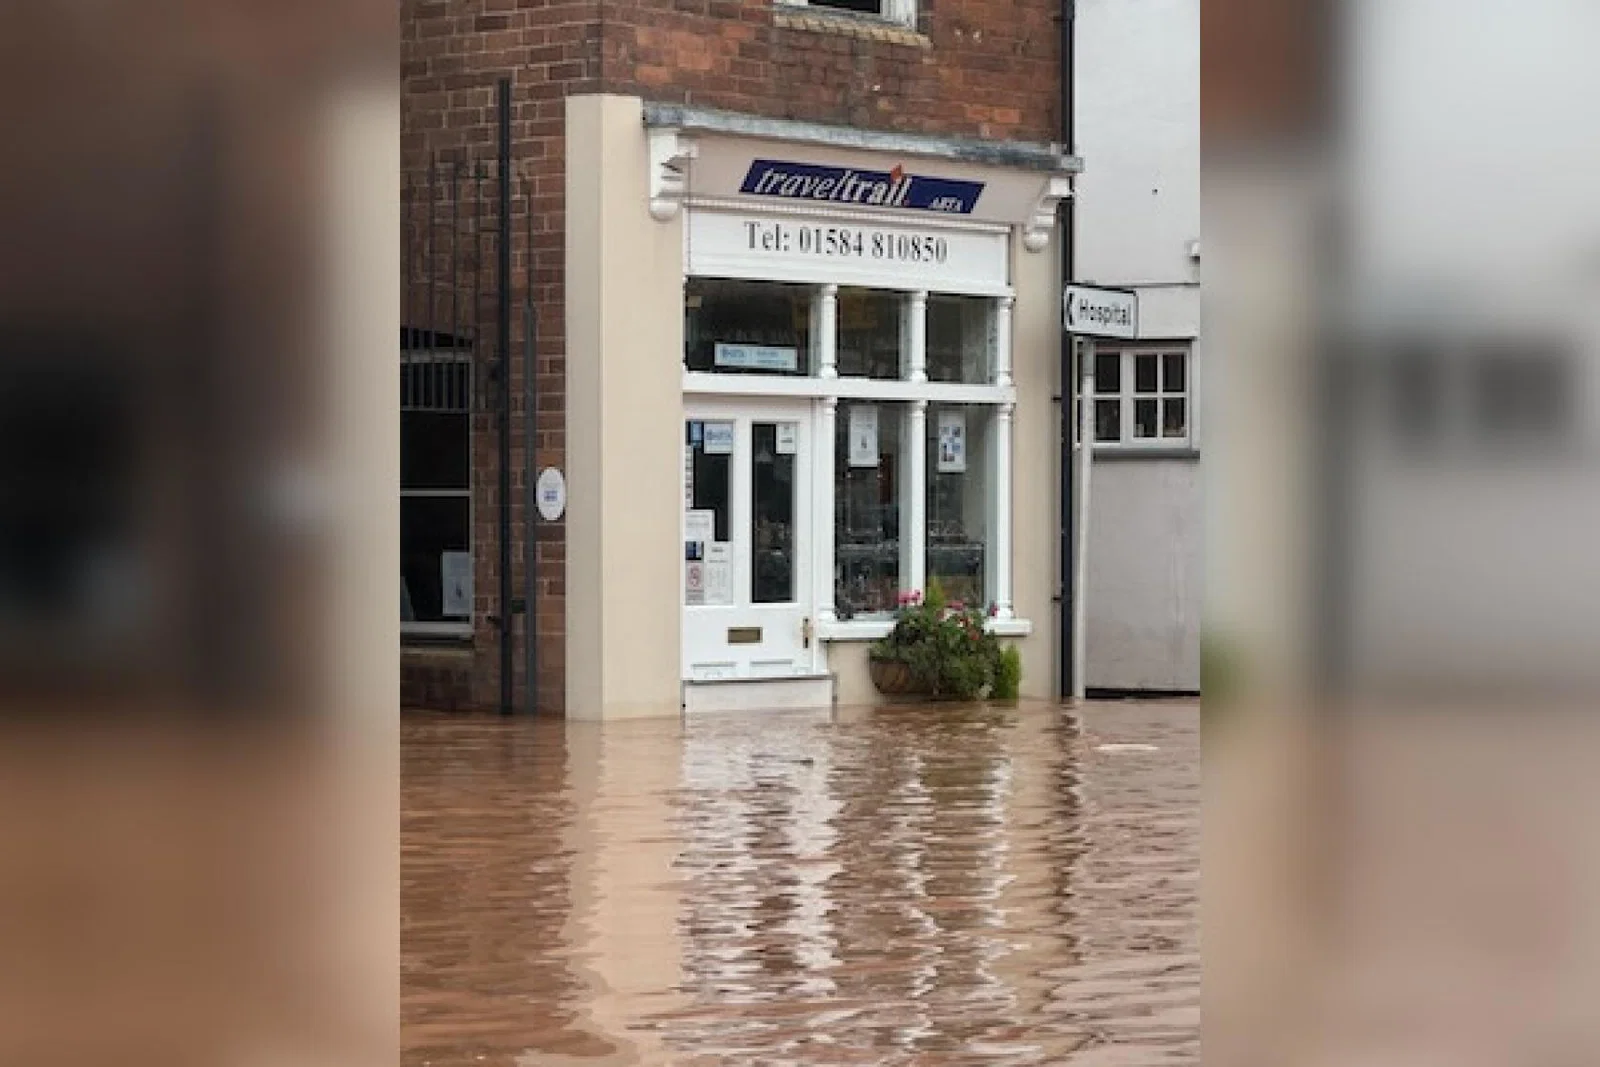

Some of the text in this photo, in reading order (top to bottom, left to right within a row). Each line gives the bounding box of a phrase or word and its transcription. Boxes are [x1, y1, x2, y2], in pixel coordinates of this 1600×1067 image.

[754, 167, 911, 206] traveltrail
[744, 221, 948, 264] Tel: 01584 810850
[1079, 298, 1131, 326] Hospital
